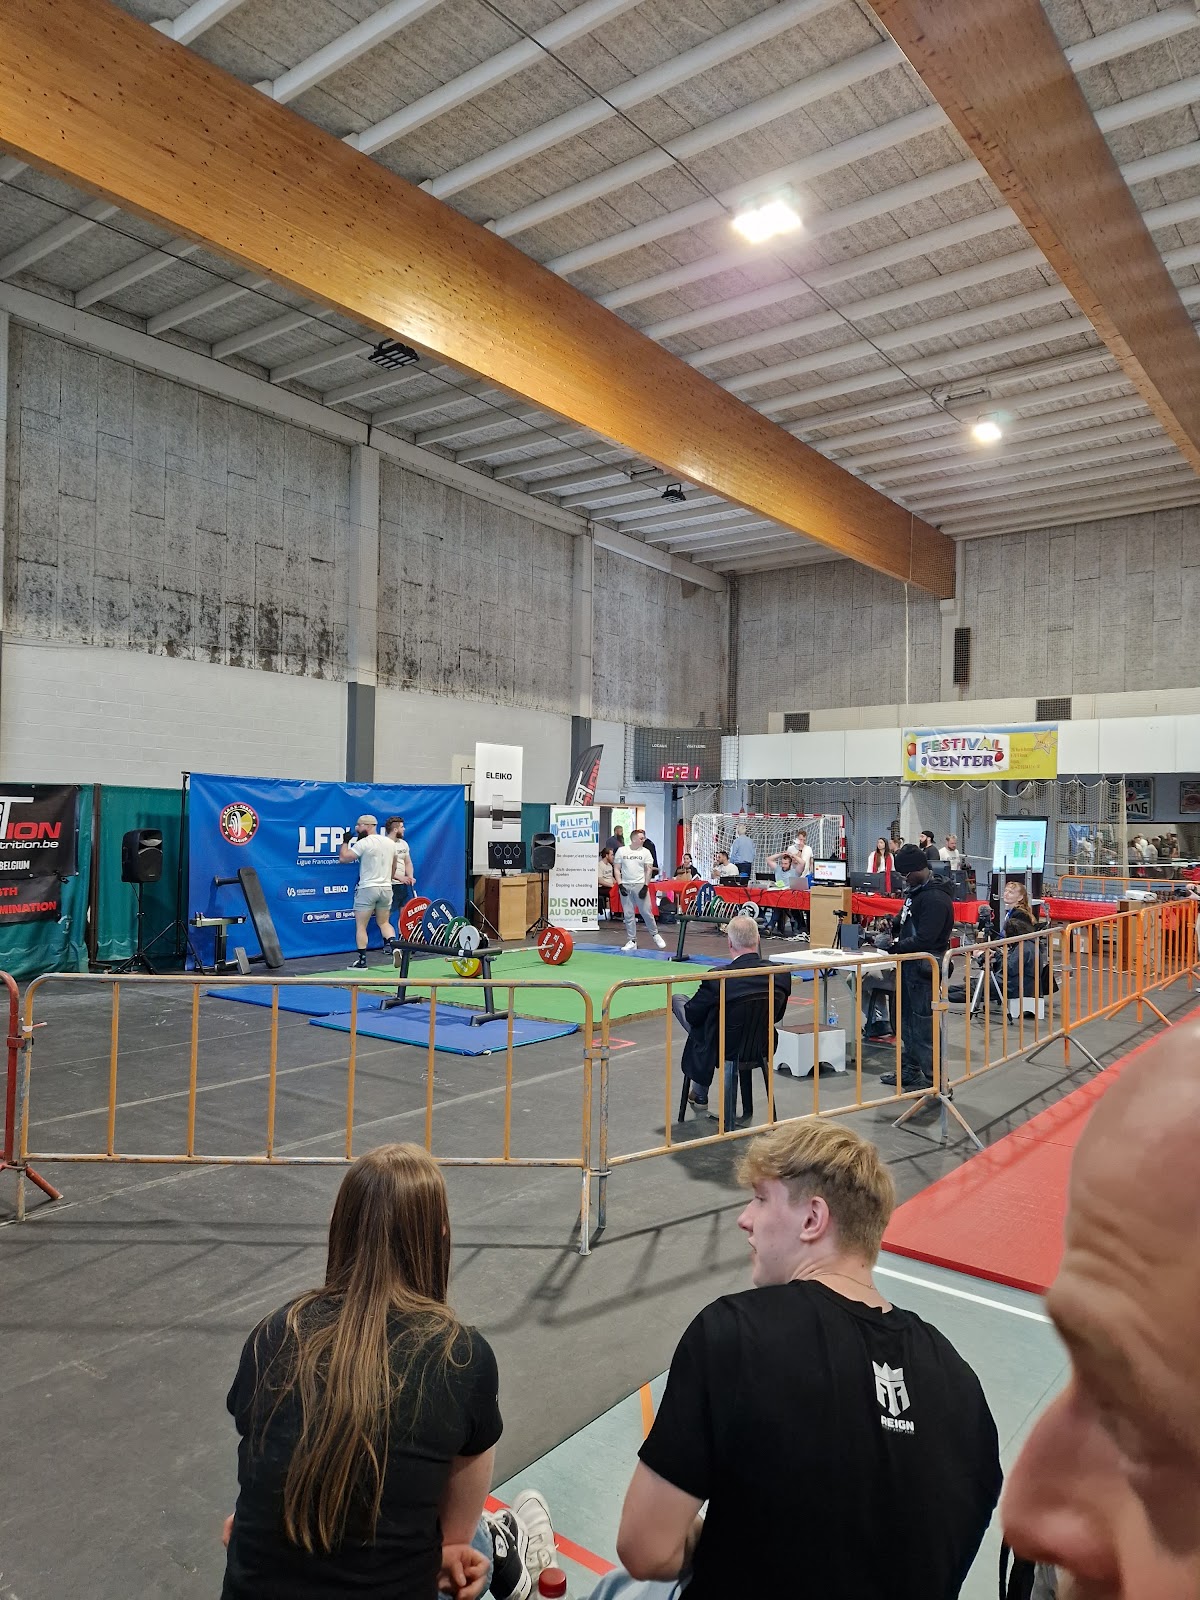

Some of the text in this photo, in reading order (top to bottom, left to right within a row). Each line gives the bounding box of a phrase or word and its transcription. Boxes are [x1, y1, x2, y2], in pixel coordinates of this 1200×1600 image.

[921, 737, 1003, 754] FESTIVAL
[928, 754, 994, 767] CENTER
[485, 771, 513, 781] ELEIKO
[661, 766, 699, 780] 12:21
[561, 830, 590, 839] CLEAN
[0, 860, 30, 871] BELGIUM
[296, 859, 311, 867] Ligue
[311, 858, 341, 866] Francopho
[323, 885, 349, 894] ELEIKO
[549, 897, 598, 908] DIS NON!
[407, 903, 428, 917] ELEIKO
[549, 908, 598, 916] AU DOPAGE
[880, 1414, 915, 1432] REIGN
